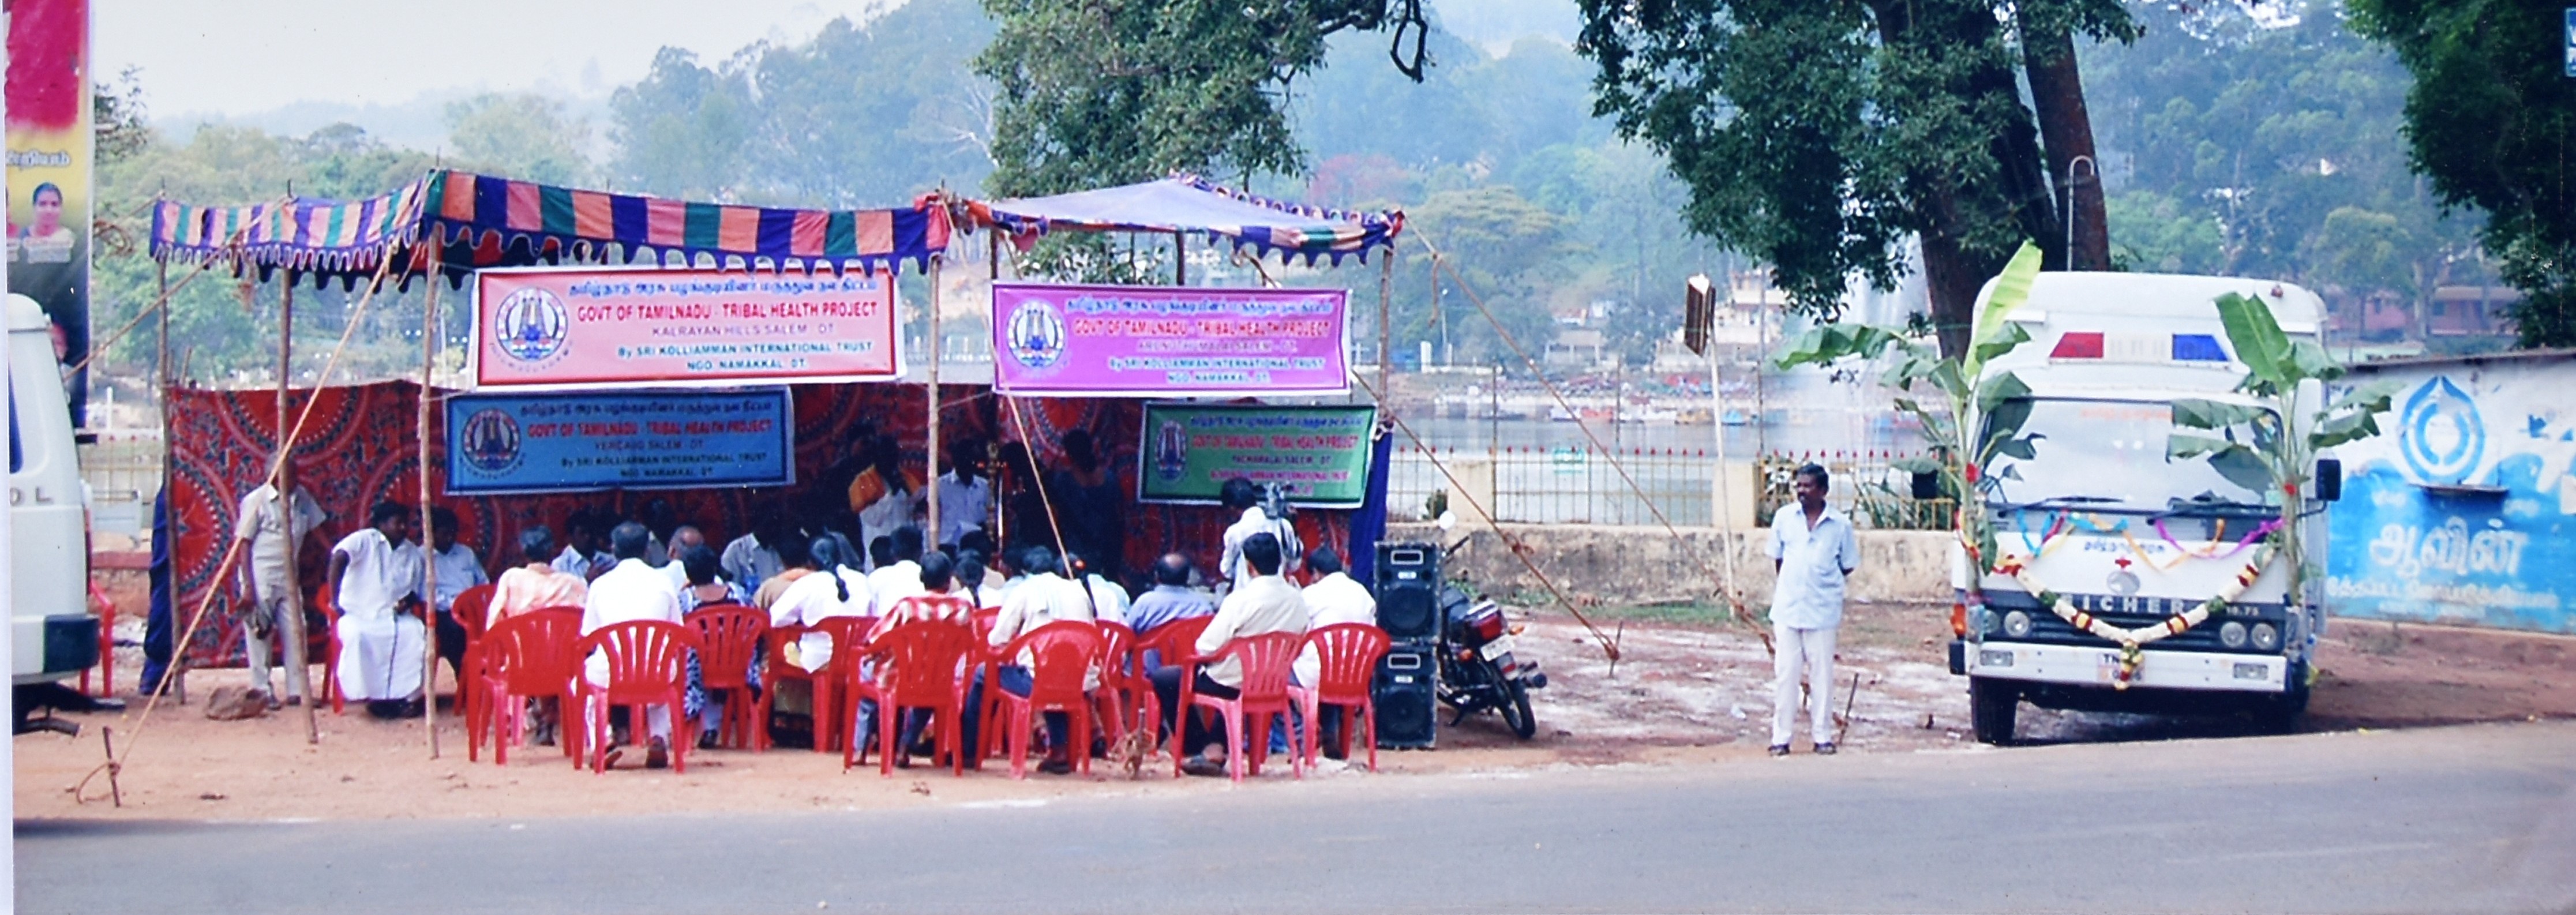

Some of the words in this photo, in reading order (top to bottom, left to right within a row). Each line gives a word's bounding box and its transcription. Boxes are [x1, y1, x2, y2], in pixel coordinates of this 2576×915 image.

[578, 306, 612, 322] GOVT
[617, 306, 632, 321] OF
[638, 303, 712, 320] TAMILNADU
[723, 303, 766, 318] TRIBAL
[771, 302, 818, 317] HEALTH
[823, 301, 877, 316] PROJECT
[653, 326, 721, 337] KALRAYAN
[724, 325, 761, 336] HILLS
[764, 324, 807, 335] SALEM
[1075, 319, 1103, 335] GOVT
[1108, 319, 1120, 335] OF
[1124, 319, 1187, 335] TAMILNADU
[1197, 320, 1235, 335] TRIBAL
[1239, 320, 1278, 336] HEALTH
[1282, 320, 1329, 336] PROJECT
[618, 346, 632, 358] By
[636, 346, 655, 357] SRI
[659, 345, 737, 356] KOLLIAMMAN
[741, 343, 832, 354] INTERNATIONAL
[837, 341, 872, 351] TRUST
[1125, 358, 1142, 369] SRI
[1213, 358, 1289, 369] INTERNATIONAL
[1293, 358, 1323, 369] TRUST
[528, 422, 557, 437] GOVT
[560, 422, 574, 437] OF
[578, 421, 638, 437] TAMILNADU
[647, 420, 681, 435] TRIBAL
[685, 420, 724, 434] HEALTH
[727, 418, 773, 433] PROJECT
[738, 452, 767, 462] TRUST
[2369, 516, 2531, 578] ஆவின்
